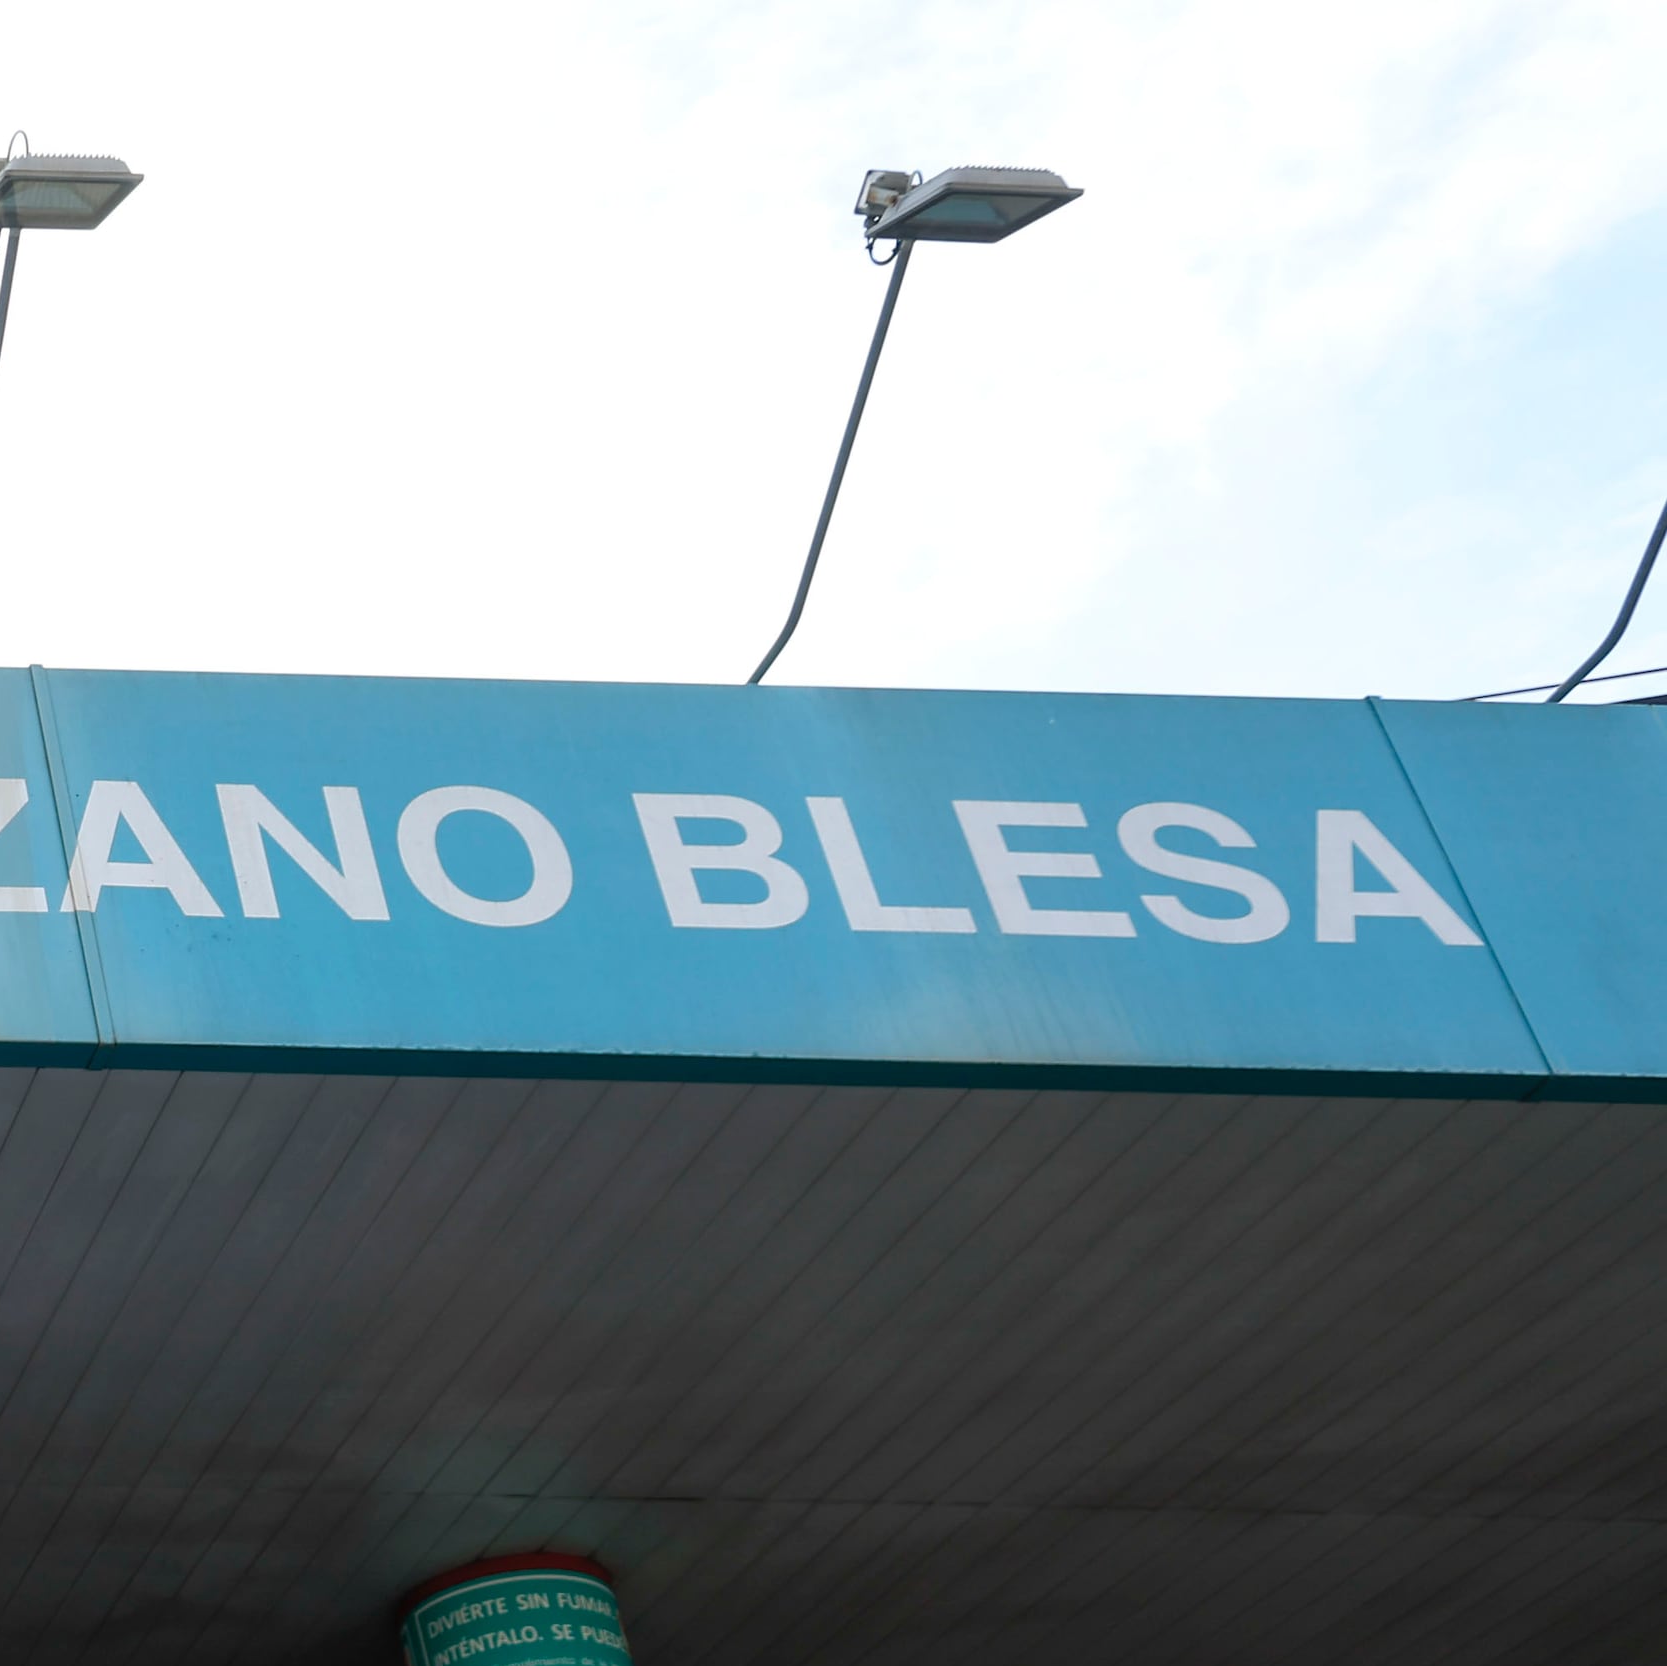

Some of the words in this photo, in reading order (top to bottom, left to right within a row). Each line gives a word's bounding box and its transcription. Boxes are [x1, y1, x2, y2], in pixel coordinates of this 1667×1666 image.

[632, 793, 1484, 946] BLESA
[428, 1597, 508, 1639] DIVIÉRTE
[516, 1593, 550, 1610] SIN
[551, 1623, 575, 1640] SE
